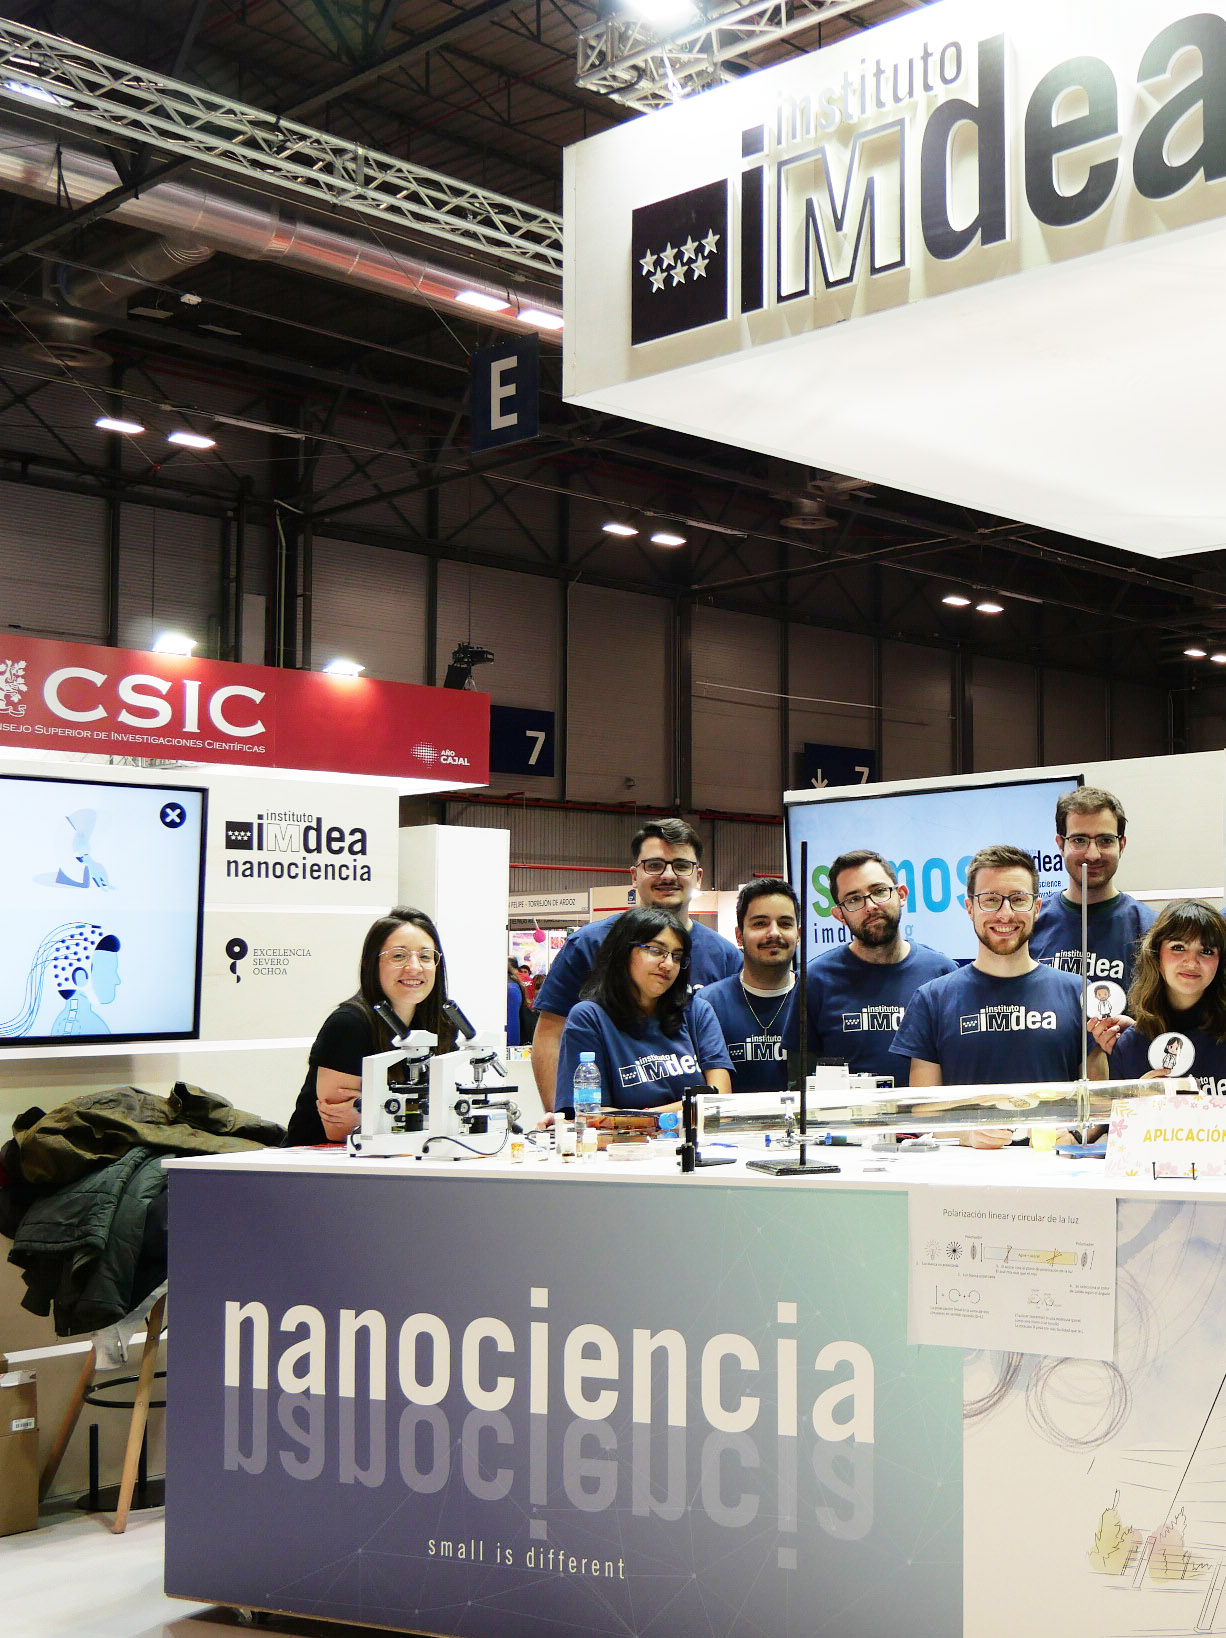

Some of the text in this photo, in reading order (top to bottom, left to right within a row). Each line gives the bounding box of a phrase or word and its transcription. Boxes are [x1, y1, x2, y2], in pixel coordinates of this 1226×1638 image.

[775, 40, 963, 147] instituto
[491, 356, 517, 430] E
[43, 666, 266, 737] CSIC
[34, 725, 91, 738] SUPERIOR
[94, 732, 108, 740] DE
[111, 731, 203, 748] INVESTIGACIONES
[205, 740, 265, 753] CIENTÍFICAS
[525, 730, 546, 765] 7
[441, 756, 470, 766] CAJAL
[266, 809, 313, 823] instituto
[226, 856, 372, 881] nanociencia
[252, 948, 312, 957] EXCELENCIA
[252, 958, 289, 966] SEVERO
[252, 967, 287, 976] OCHOA
[867, 1004, 899, 1012] instituto
[985, 1005, 1020, 1014] instituto
[751, 1034, 782, 1043] instituto
[638, 1053, 671, 1066] instituto
[942, 1208, 1080, 1224] Polarización linear y circular de la luz
[224, 1286, 876, 1444] nanociencia
[427, 1535, 627, 1580] small is different
